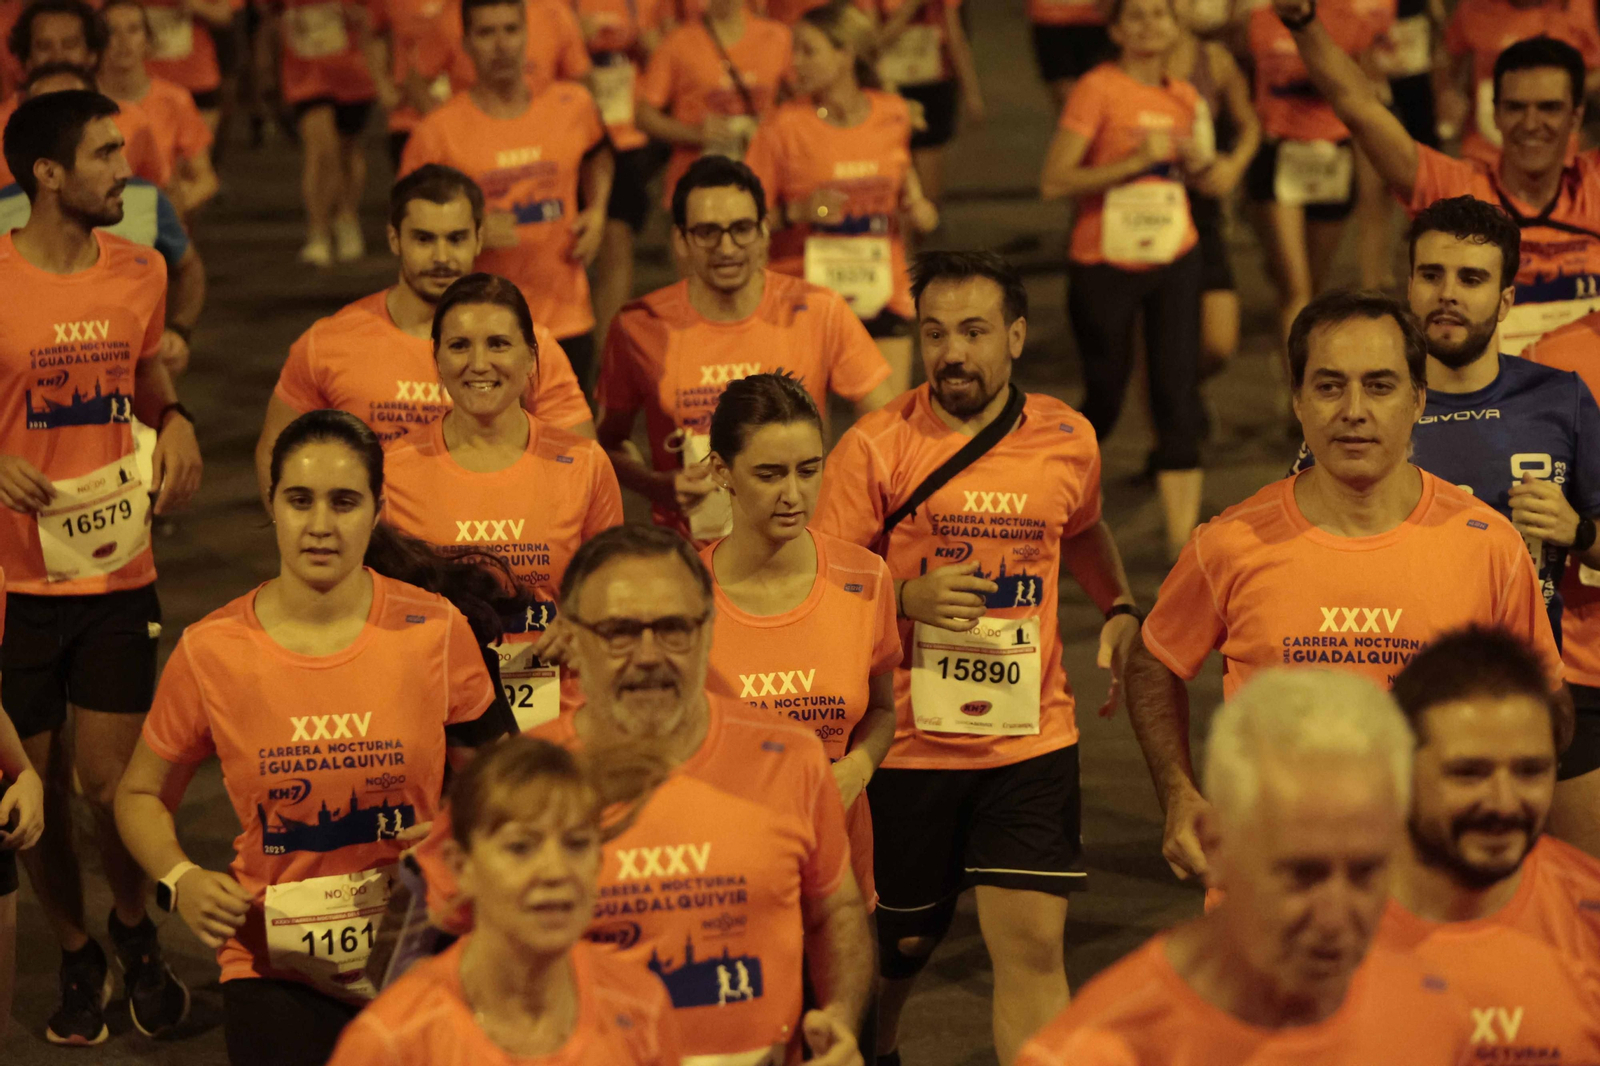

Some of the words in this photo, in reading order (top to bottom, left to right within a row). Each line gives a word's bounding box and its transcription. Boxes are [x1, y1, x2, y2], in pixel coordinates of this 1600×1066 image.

[54, 320, 110, 343] XXXV
[30, 344, 76, 357] CARRERA
[80, 341, 130, 351] NOCTURNA
[39, 350, 130, 368] GUADALQUIVIR
[370, 401, 417, 411] CARRERA
[422, 403, 449, 413] NOCT
[1417, 408, 1500, 425] GIVOVA
[1553, 461, 1567, 484] 023
[963, 490, 1028, 515] XXXV
[61, 498, 132, 538] 16579
[932, 513, 985, 526] CARRERA
[990, 516, 1047, 529] NOCTURNA
[455, 518, 525, 542] XXXV
[940, 525, 1045, 541] GUADALQUIVIR
[486, 543, 550, 553] NOCTURNA
[499, 554, 551, 567] QUIVIR
[1318, 606, 1404, 633] XXXV
[1282, 636, 1349, 647] CARRERA
[1354, 637, 1429, 650] NOCTURNA
[937, 656, 1021, 685] 15890
[738, 668, 816, 698] XXXV
[774, 696, 846, 709] NOCTURNA
[290, 711, 372, 742] XXXV
[787, 708, 846, 722] QUIVIR
[258, 744, 322, 759] CARRERA
[328, 738, 403, 753] NOCTURNA
[268, 752, 405, 775] GUADALQUIVIR
[616, 842, 711, 880] XXXV
[600, 882, 653, 898] RRERA
[660, 874, 748, 891] NOCTURNA
[301, 921, 375, 957] 1161
[1470, 1007, 1523, 1044] XV
